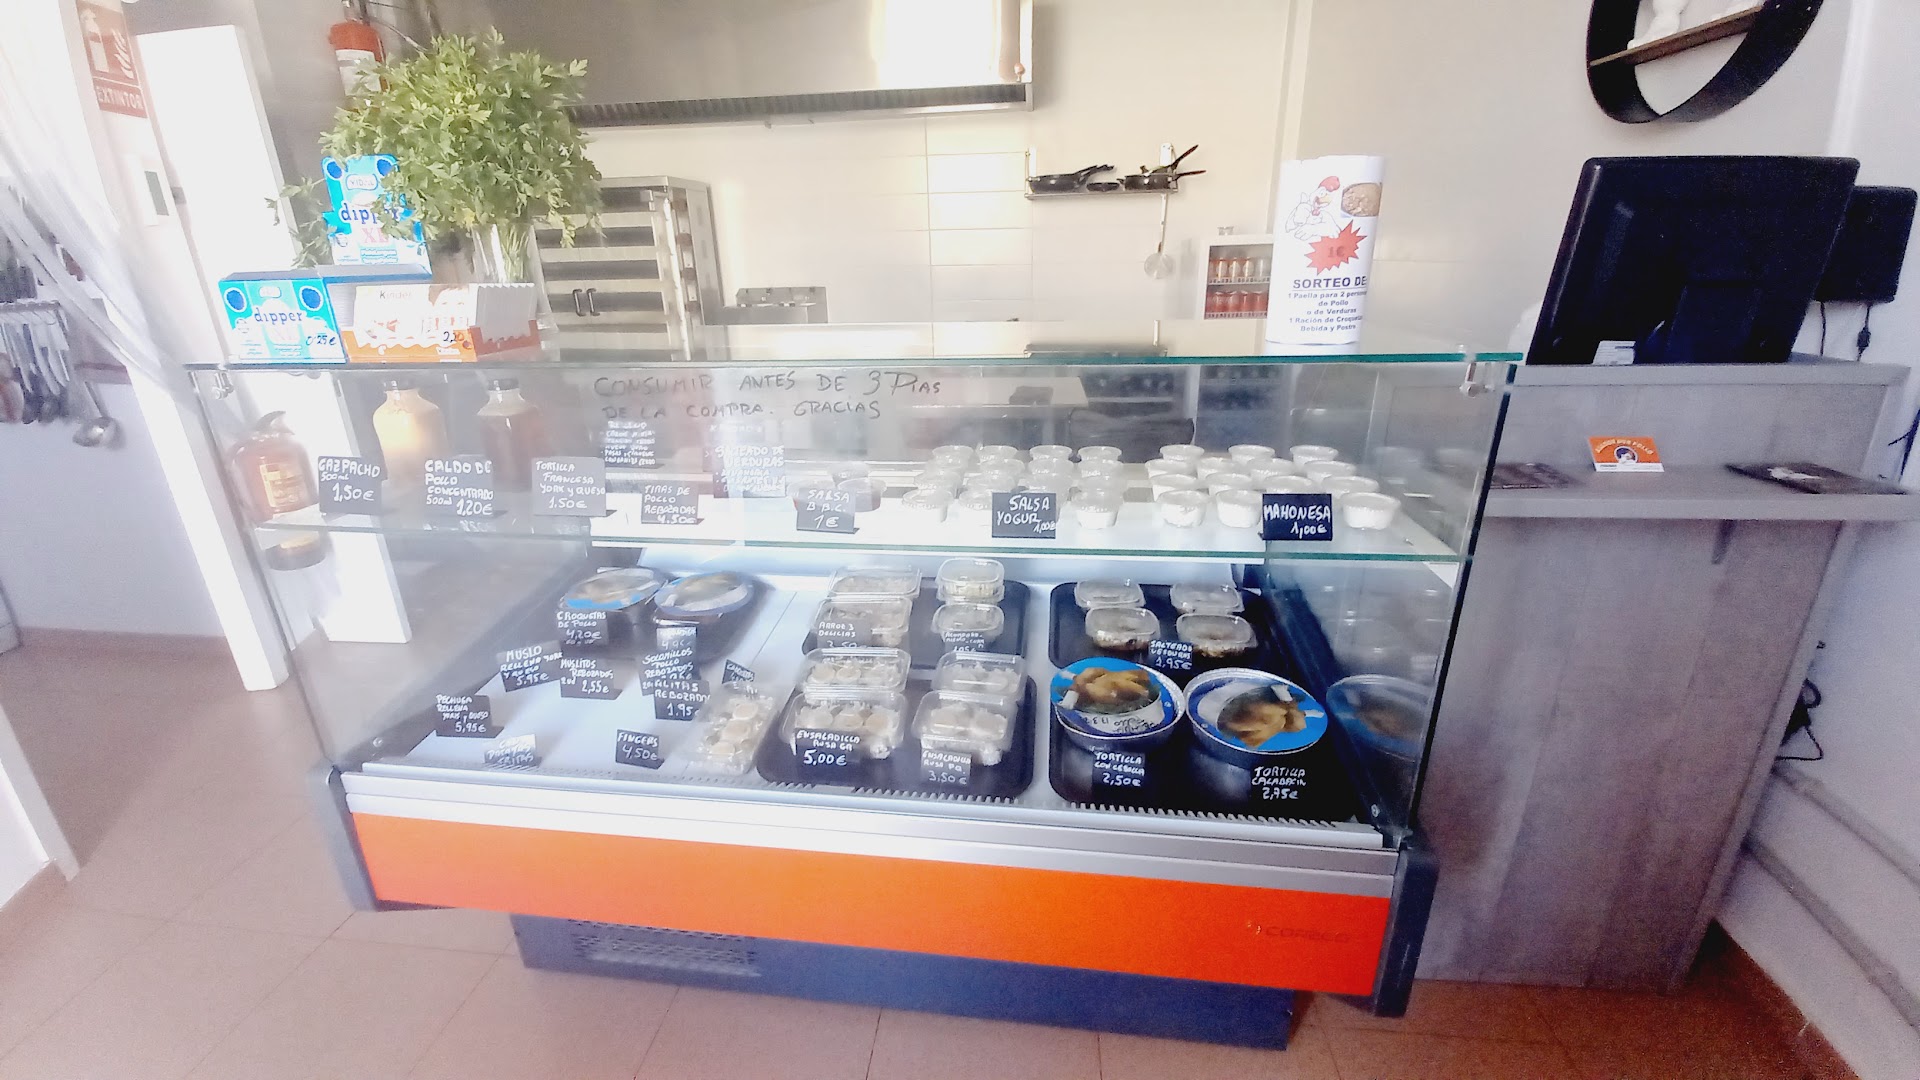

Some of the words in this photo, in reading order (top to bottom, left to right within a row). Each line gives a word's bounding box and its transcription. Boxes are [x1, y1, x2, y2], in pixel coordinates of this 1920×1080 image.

[1293, 277, 1351, 289] SORTEO
[1330, 299, 1349, 307] Pollo
[254, 307, 303, 325] dipper
[1326, 307, 1357, 315] Verduras
[594, 374, 714, 397] CONSUMIR
[739, 371, 795, 391] ANTES
[816, 373, 847, 391] DE
[863, 370, 881, 395] 3
[602, 406, 627, 418] DE
[640, 404, 667, 419] LA
[794, 400, 881, 419] GRACIAS
[318, 457, 381, 478] GAZPACHO
[425, 459, 472, 474] CALDO
[475, 460, 492, 474] DE
[535, 460, 576, 472] TORTILLA
[542, 471, 594, 485] FRANCESA
[427, 486, 494, 500] CONCENTRADO
[540, 482, 565, 494] YORK
[644, 485, 673, 494] TIRAS
[676, 486, 691, 496] DE
[644, 493, 676, 503] POLLO
[807, 489, 850, 503] SALSA
[644, 504, 697, 515] REBOZADAS
[1009, 494, 1050, 512] SALSA
[997, 510, 1042, 526] YOGUR
[1263, 503, 1331, 523] MAHONESA
[1290, 521, 1328, 539] 1,00€
[556, 611, 607, 620] CROQUETAS
[558, 620, 569, 628] DE
[818, 630, 856, 638] DELICIAS
[506, 645, 542, 662] MUSLO
[500, 656, 541, 672] RELLENO
[654, 679, 699, 692] ALITAS
[436, 694, 472, 704] PECHUGA
[617, 732, 658, 748] FINGERS
[796, 730, 861, 744] ENSALADILLA
[812, 740, 837, 749] RUSA
[923, 759, 944, 768] RUSA
[1095, 751, 1142, 764] TORTILLA
[1094, 762, 1111, 770] CON
[1254, 766, 1306, 777] TORTILLA
[1102, 772, 1142, 786] 2,50€
